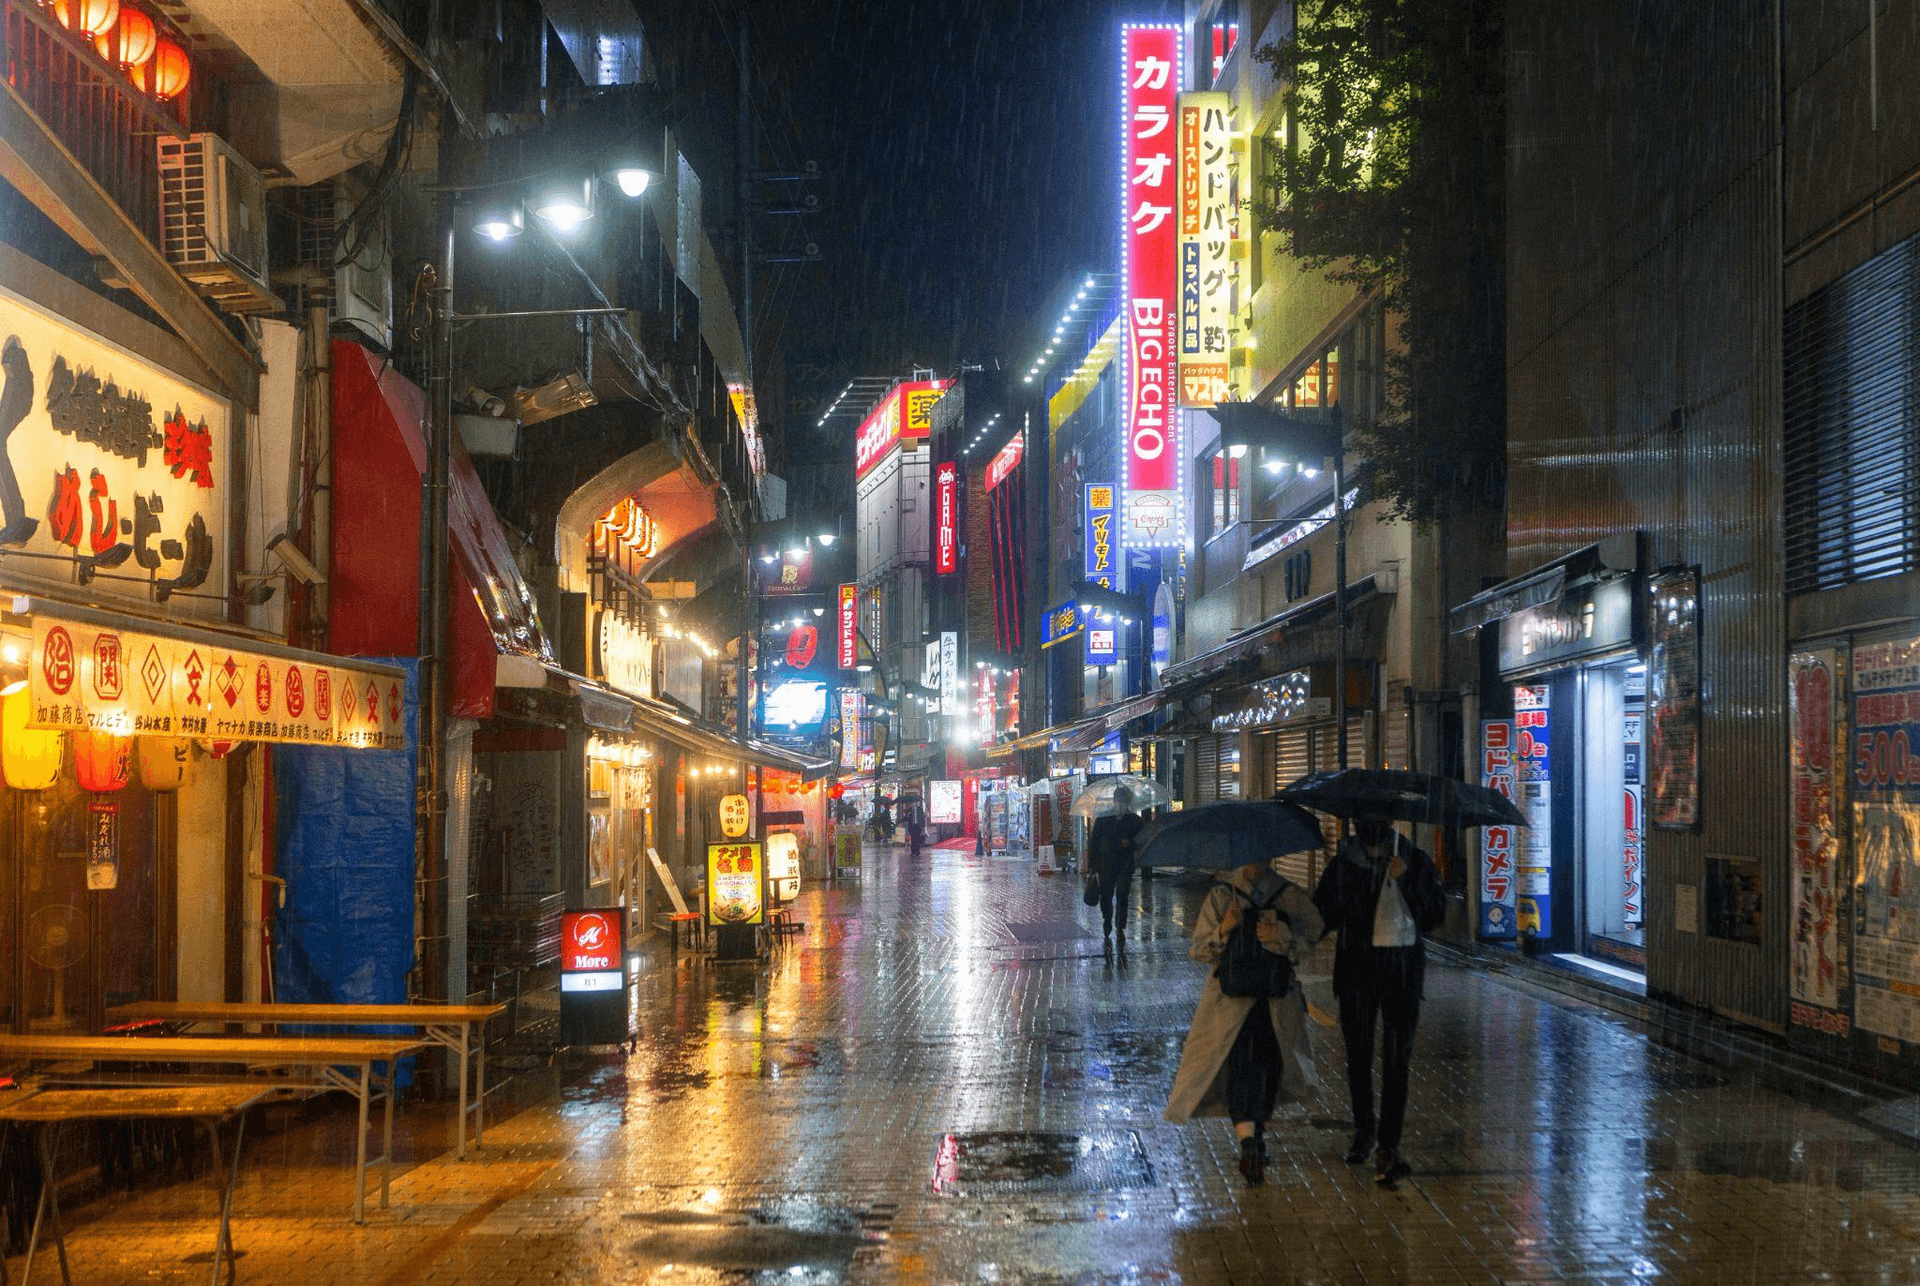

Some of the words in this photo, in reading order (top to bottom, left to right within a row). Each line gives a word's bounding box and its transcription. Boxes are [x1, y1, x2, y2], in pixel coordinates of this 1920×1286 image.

[1131, 56, 1172, 235] カラオケ
[1132, 298, 1164, 361] BIG
[1167, 313, 1177, 357] Karaoke
[1167, 362, 1177, 444] Entertainment
[1184, 367, 1224, 375] バッグハウス
[1132, 368, 1165, 460] ECHO
[941, 485, 954, 567] GAME
[36, 704, 84, 726] 加藤商店
[217, 717, 246, 734] ヤマナカ
[1486, 723, 1511, 902] ヨドバカメラ
[574, 955, 609, 968] More
